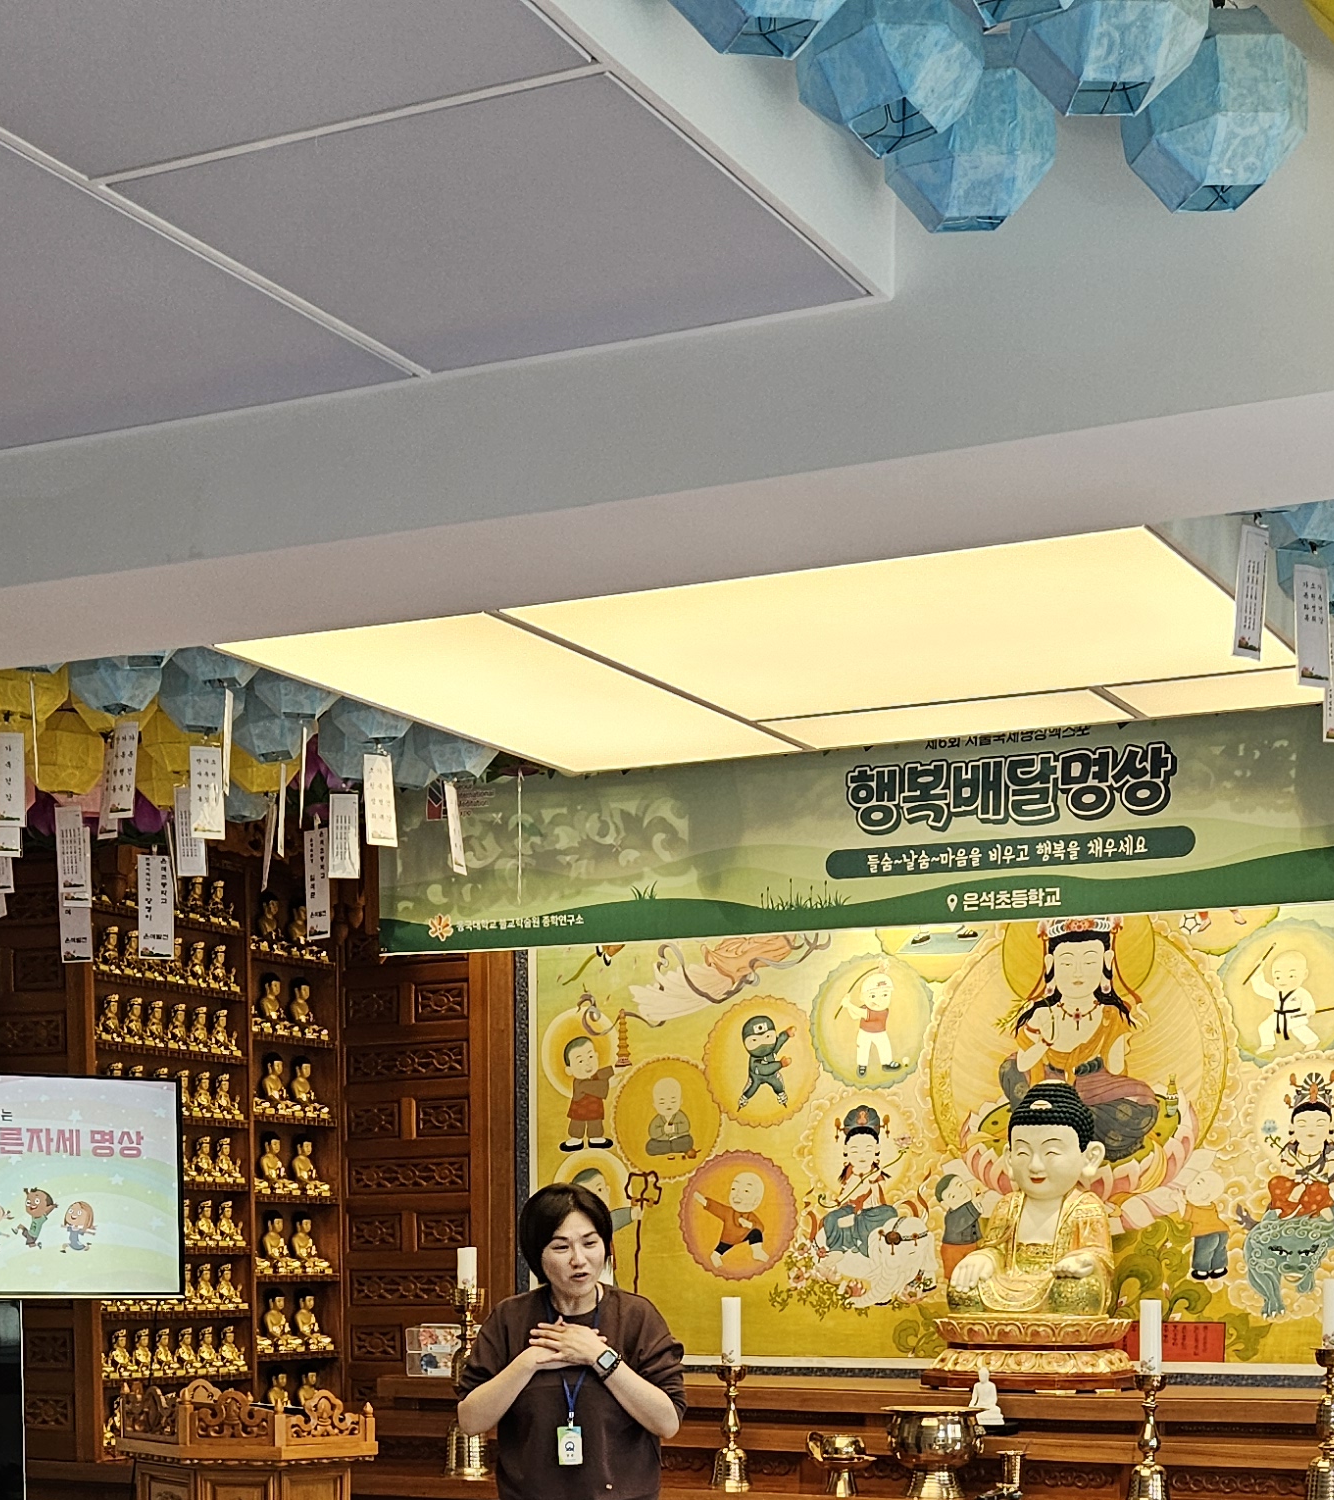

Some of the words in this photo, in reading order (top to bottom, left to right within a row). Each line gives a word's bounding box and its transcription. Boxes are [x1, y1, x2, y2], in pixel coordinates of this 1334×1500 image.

[845, 742, 1177, 834] 행복배달명상
[867, 847, 983, 874] 들숨~날숨~마음을
[988, 844, 1031, 864] 비우고
[1035, 840, 1081, 862] 행복을
[1087, 835, 1149, 859] 채우세요
[962, 888, 1062, 912] 은석초등학교
[90, 1130, 144, 1158] 명상
